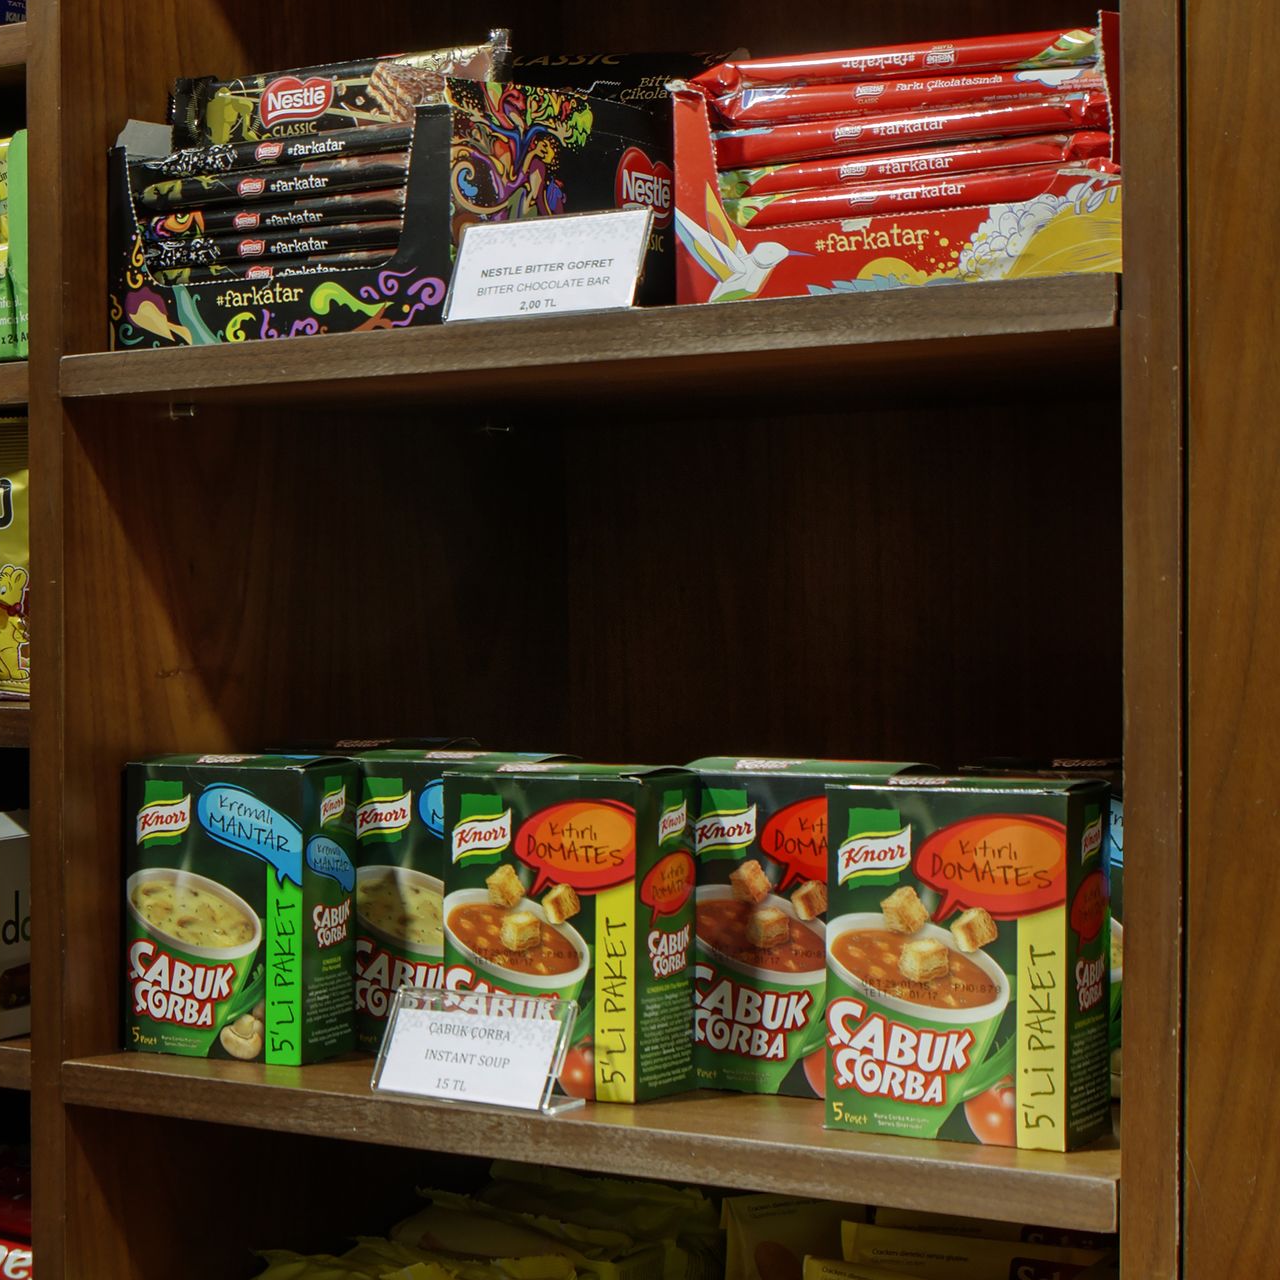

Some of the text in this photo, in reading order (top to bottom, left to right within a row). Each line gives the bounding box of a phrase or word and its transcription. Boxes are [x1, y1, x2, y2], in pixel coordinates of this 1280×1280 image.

[267, 85, 326, 111] Nestlé
[272, 122, 317, 137] CLASSIC
[287, 139, 345, 156] #farkatar
[270, 176, 328, 193] #farkatar
[888, 182, 965, 202] #farkatar
[270, 238, 328, 254] #farkatar
[814, 224, 929, 253] #farkatar
[481, 258, 614, 278] NESTLE BITTER GOFRET
[216, 283, 303, 308] #farkatar
[477, 275, 610, 297] BITTER CHOCOLATE BAR
[520, 297, 556, 311] 2,00 TL
[138, 810, 187, 830] Knorr
[697, 820, 754, 844] Knorr
[209, 812, 291, 853] MANTAR
[454, 825, 509, 849] Knorr
[526, 836, 625, 867] DOMATES
[841, 843, 908, 870] Knorr
[931, 852, 1053, 890] DOMATES
[130, 940, 234, 1002] ÇABUK
[134, 979, 213, 1026] ÇORBA
[428, 1022, 510, 1041] ÇABUK ÇORBA
[827, 1000, 973, 1072] ÇABUK
[424, 1048, 510, 1070] INSTANT SOUP
[435, 1078, 466, 1092] 15 TL
[834, 1049, 944, 1104] ÇORBA
